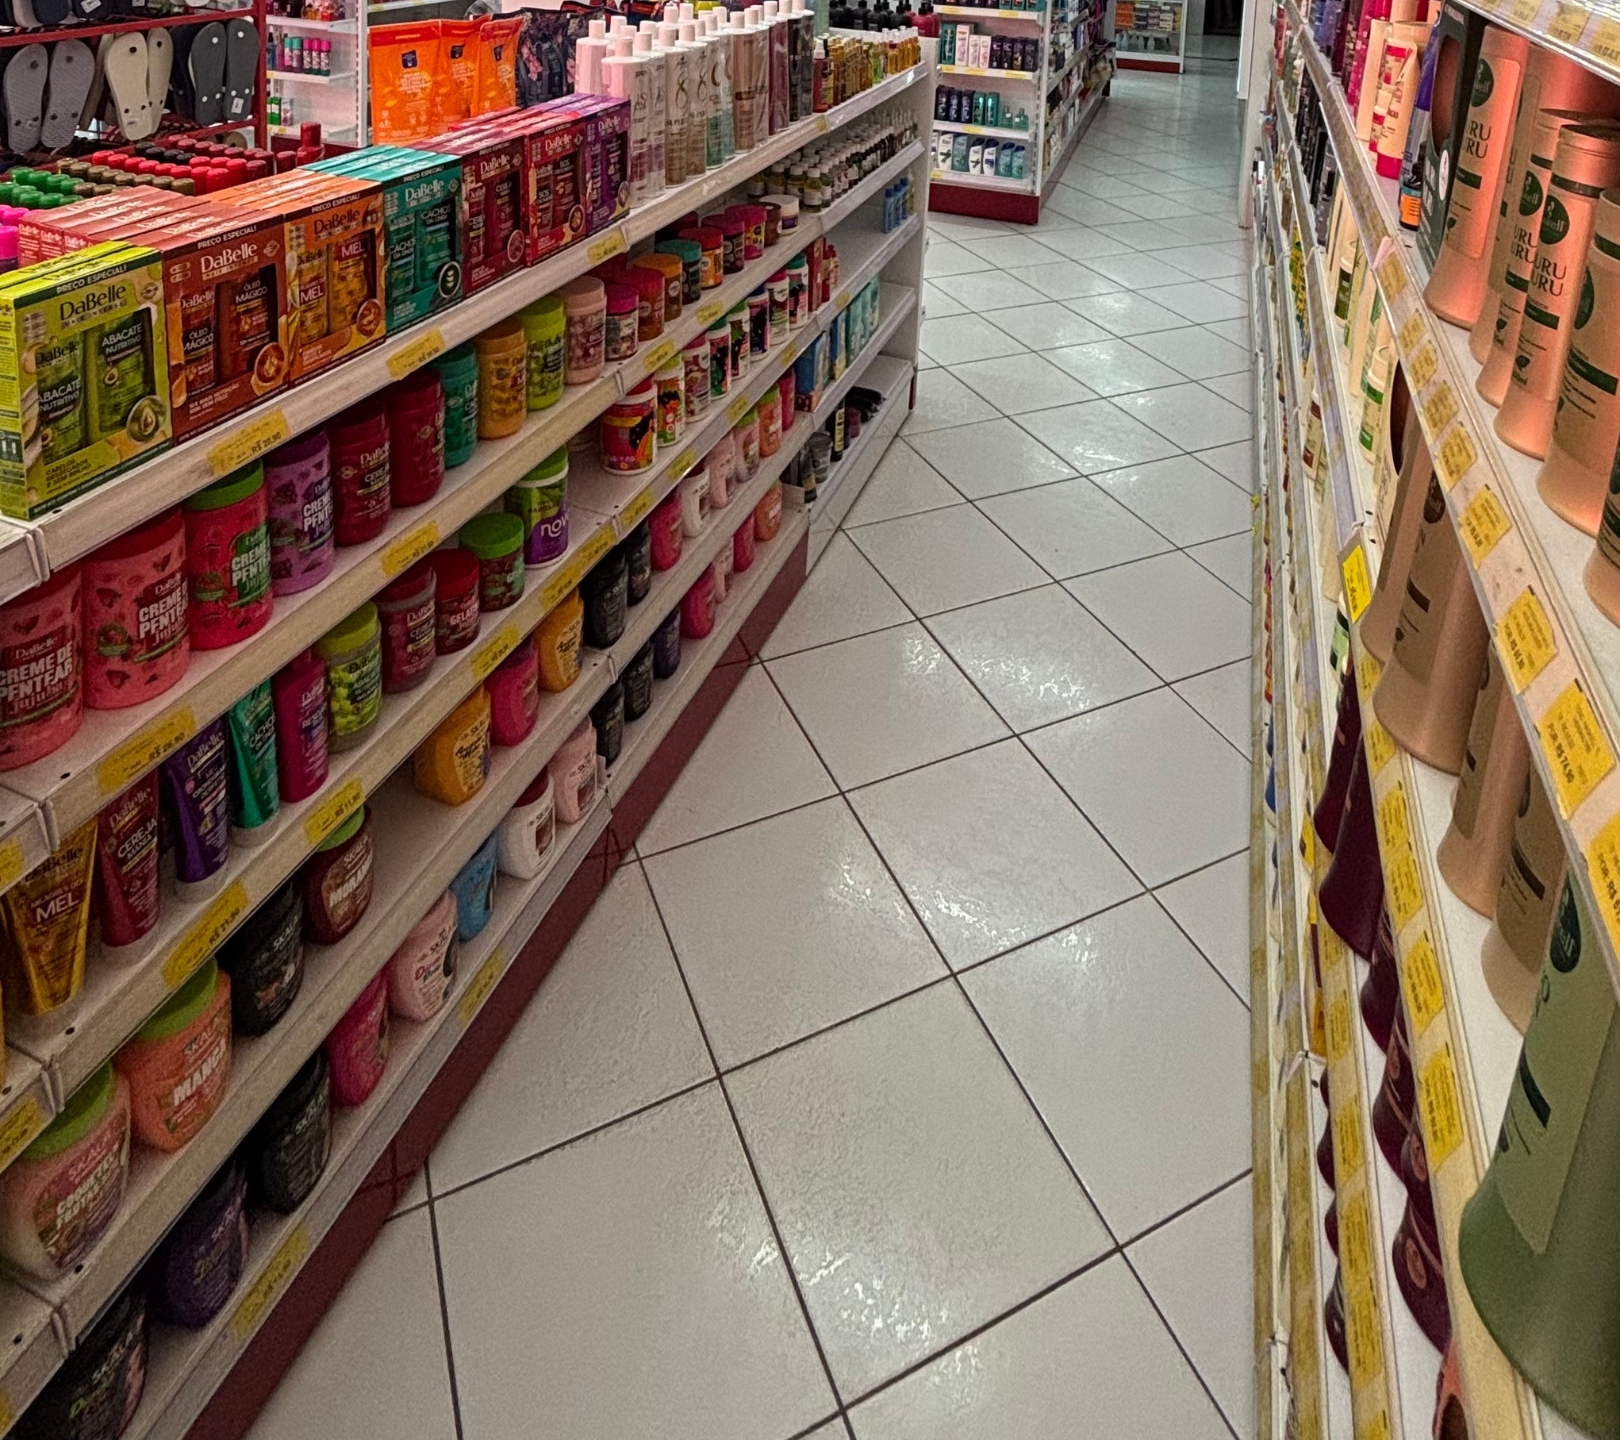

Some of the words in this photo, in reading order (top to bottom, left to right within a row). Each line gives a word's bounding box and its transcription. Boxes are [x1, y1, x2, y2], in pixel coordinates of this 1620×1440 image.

[480, 153, 511, 175] DaBelle
[312, 202, 332, 213] PREÇO
[333, 193, 360, 209] ESPECIAL!
[405, 180, 444, 202] DaBelle
[313, 210, 360, 235] DaBelle
[197, 235, 222, 250] PREÇO
[223, 225, 257, 243] ESPECIAL!
[341, 240, 365, 258] MEL
[200, 242, 258, 274] DaBelle
[56, 278, 86, 296] PREÇO
[87, 265, 127, 286] ESPECIAL!
[243, 279, 261, 293] ÓLEO
[59, 284, 127, 321] DaBelle
[235, 285, 268, 304] MÁGICO
[300, 285, 324, 305] MEL
[101, 321, 143, 348] ABACATE
[105, 333, 142, 355] NUTRITIVO
[189, 327, 208, 340] ÓLEO
[36, 339, 79, 365] DaBelle
[138, 586, 181, 622] CREME
[16, 636, 58, 660] DaBelle
[0, 652, 55, 687] CREME
[56, 640, 73, 665] DE
[187, 730, 224, 765] DaBelle
[1555, 742, 1566, 759] R$
[109, 787, 153, 827] DaBelle
[117, 816, 158, 859] CEREJA
[1607, 880, 1618, 901] R$
[36, 891, 80, 924] MEL
